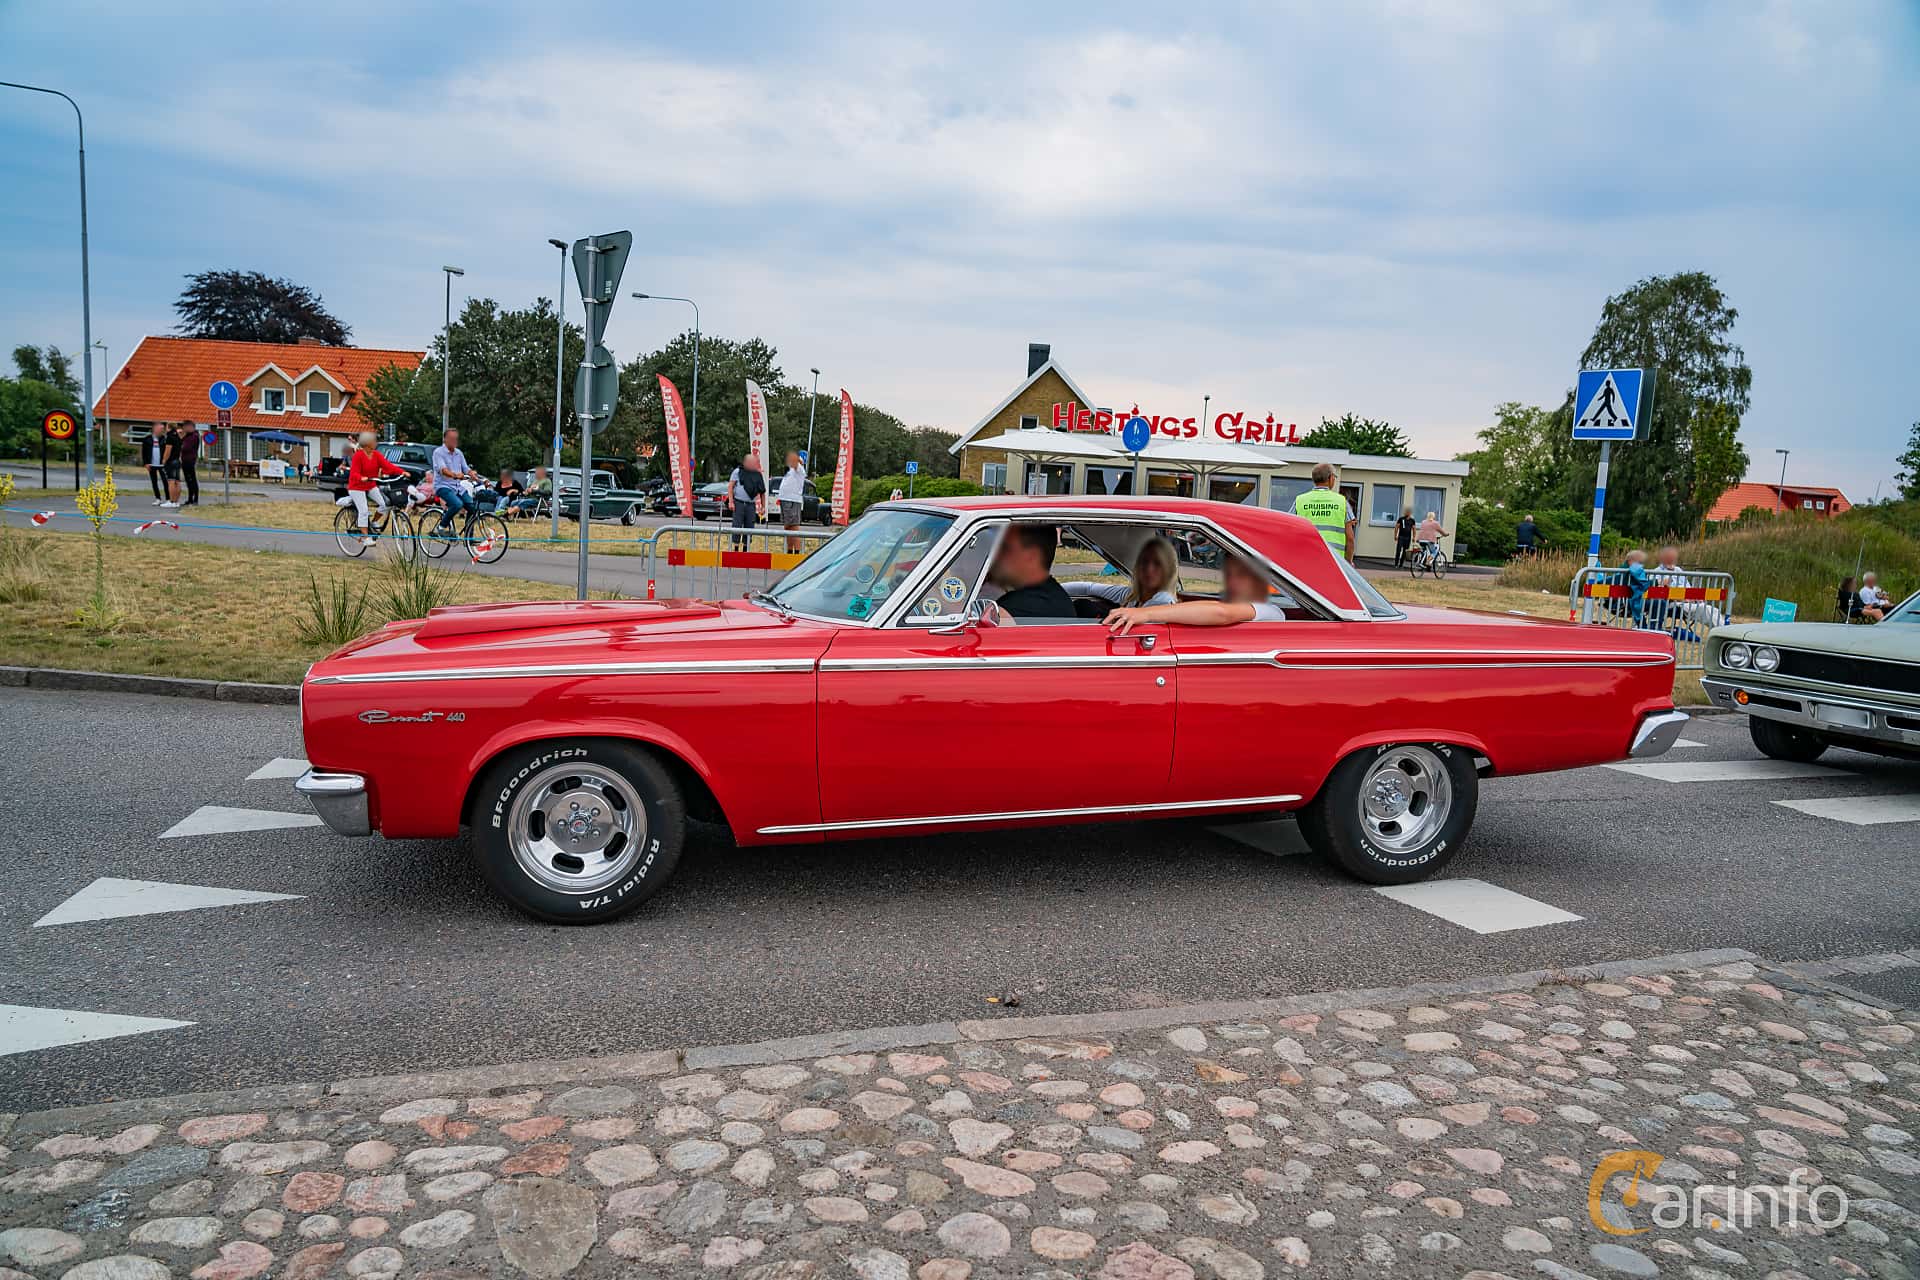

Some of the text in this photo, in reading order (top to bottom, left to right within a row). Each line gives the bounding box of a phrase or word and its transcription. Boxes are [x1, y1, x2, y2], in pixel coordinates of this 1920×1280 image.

[51, 418, 70, 432] 30
[1053, 402, 1300, 444] HERTNGS GRILL
[358, 709, 466, 725] Coronet 440
[492, 748, 588, 828] BFGoodrich
[1360, 839, 1448, 867] BFGoodrich
[579, 838, 661, 909] Radial T/A
